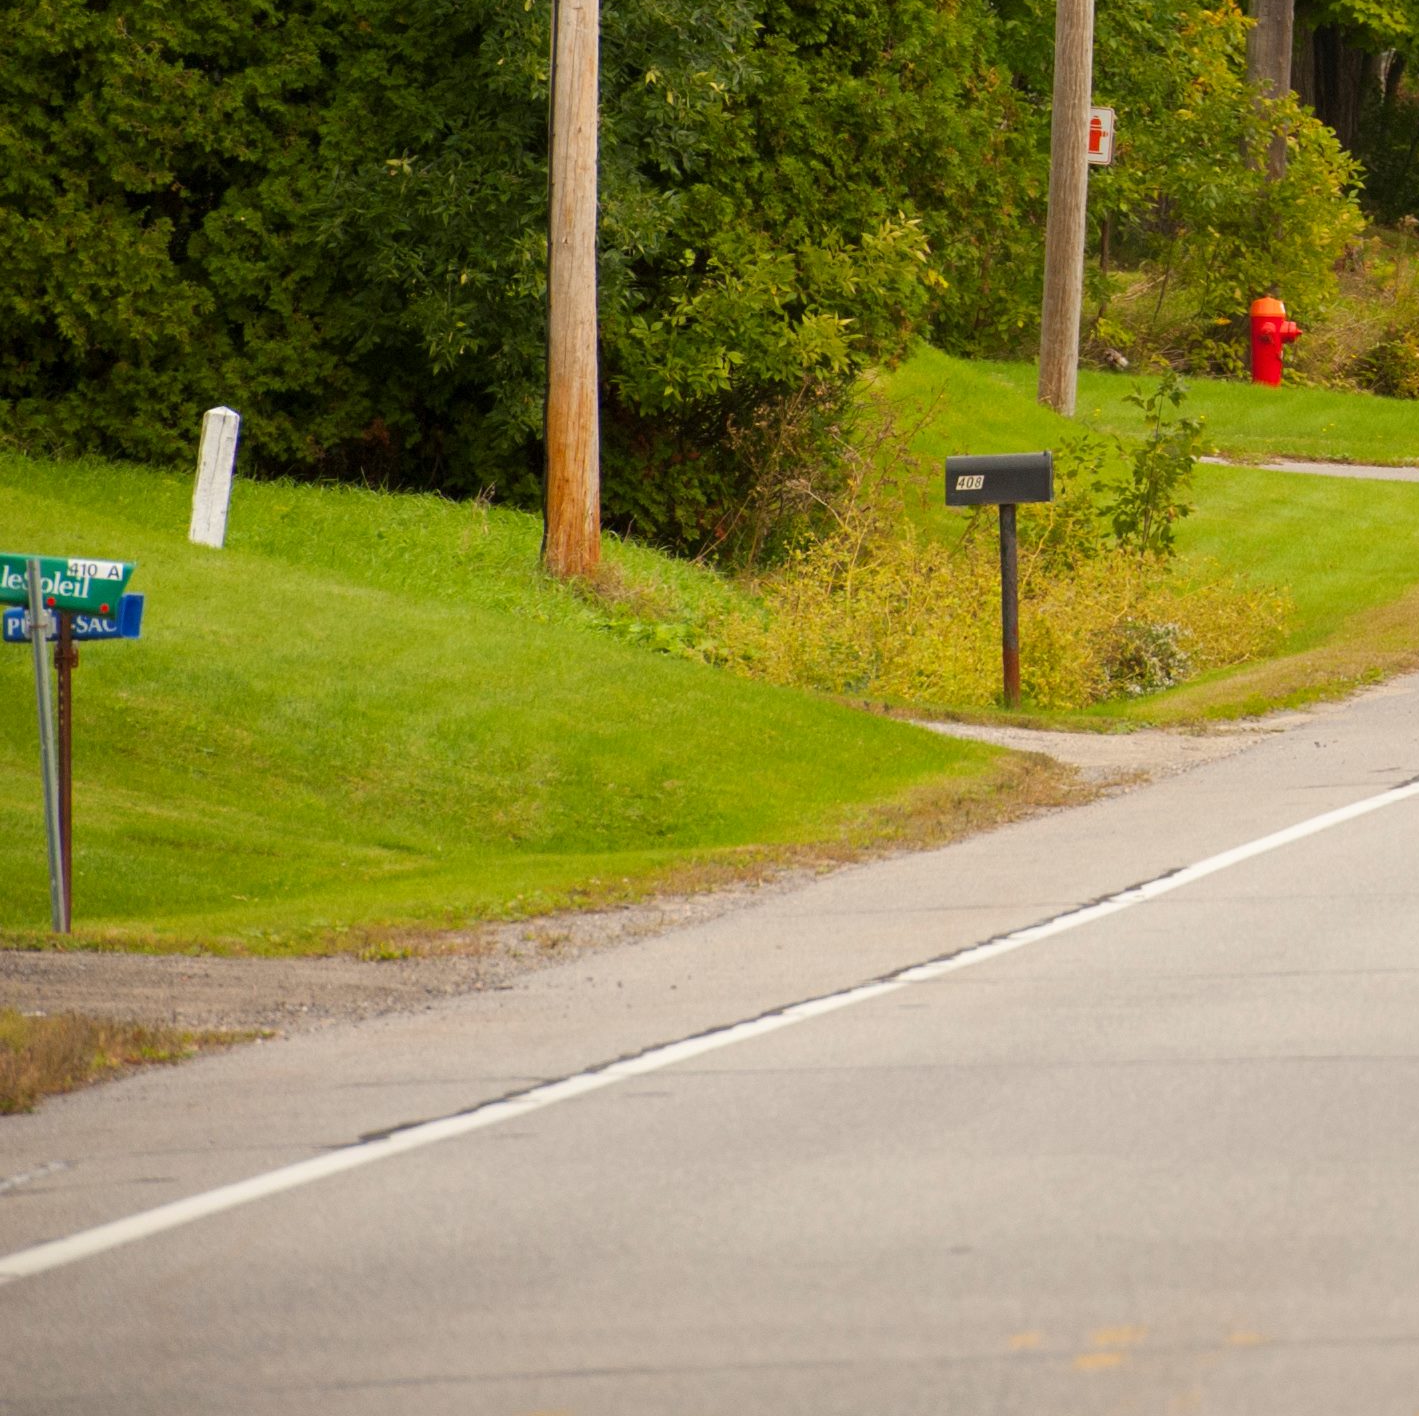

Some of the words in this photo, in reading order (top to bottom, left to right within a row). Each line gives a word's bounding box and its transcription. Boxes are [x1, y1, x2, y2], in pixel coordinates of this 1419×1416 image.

[958, 476, 982, 489] 408
[69, 563, 98, 577] 410
[107, 565, 120, 578] A
